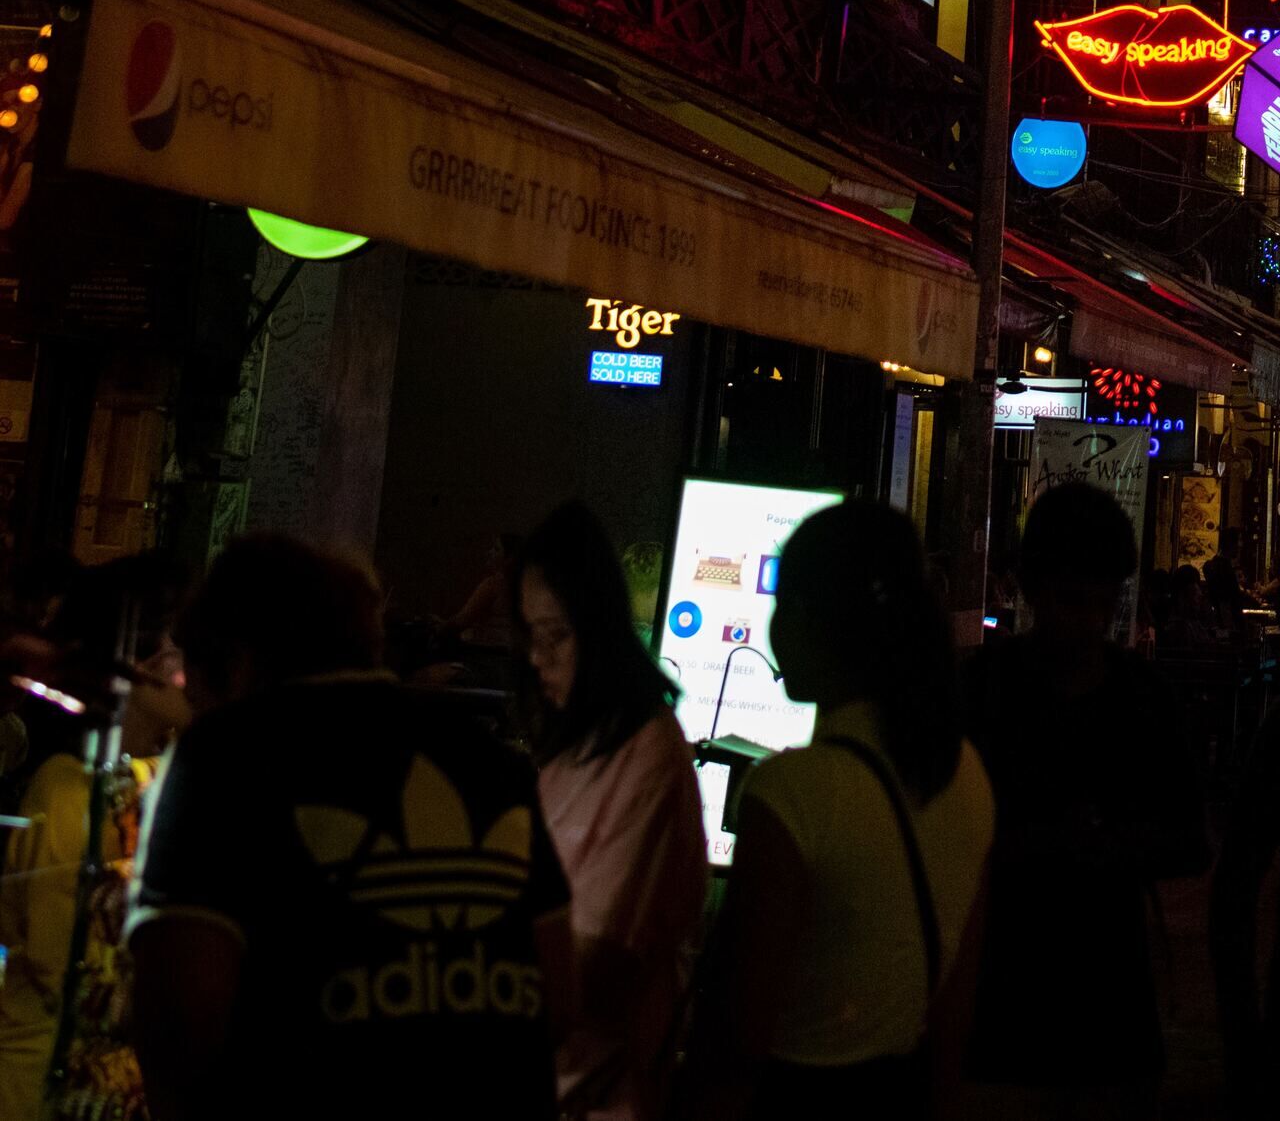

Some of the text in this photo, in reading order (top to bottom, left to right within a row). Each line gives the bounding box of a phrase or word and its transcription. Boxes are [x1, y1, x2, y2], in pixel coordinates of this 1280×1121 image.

[1066, 30, 1119, 65] easy
[1126, 33, 1233, 68] speaking
[1018, 145, 1078, 159] easy speaking
[585, 297, 681, 349] Tiger
[592, 353, 662, 369] COLD BEER
[591, 368, 660, 385] SOLD HERE
[1017, 401, 1079, 418] speaking
[320, 938, 543, 1023] adidas
